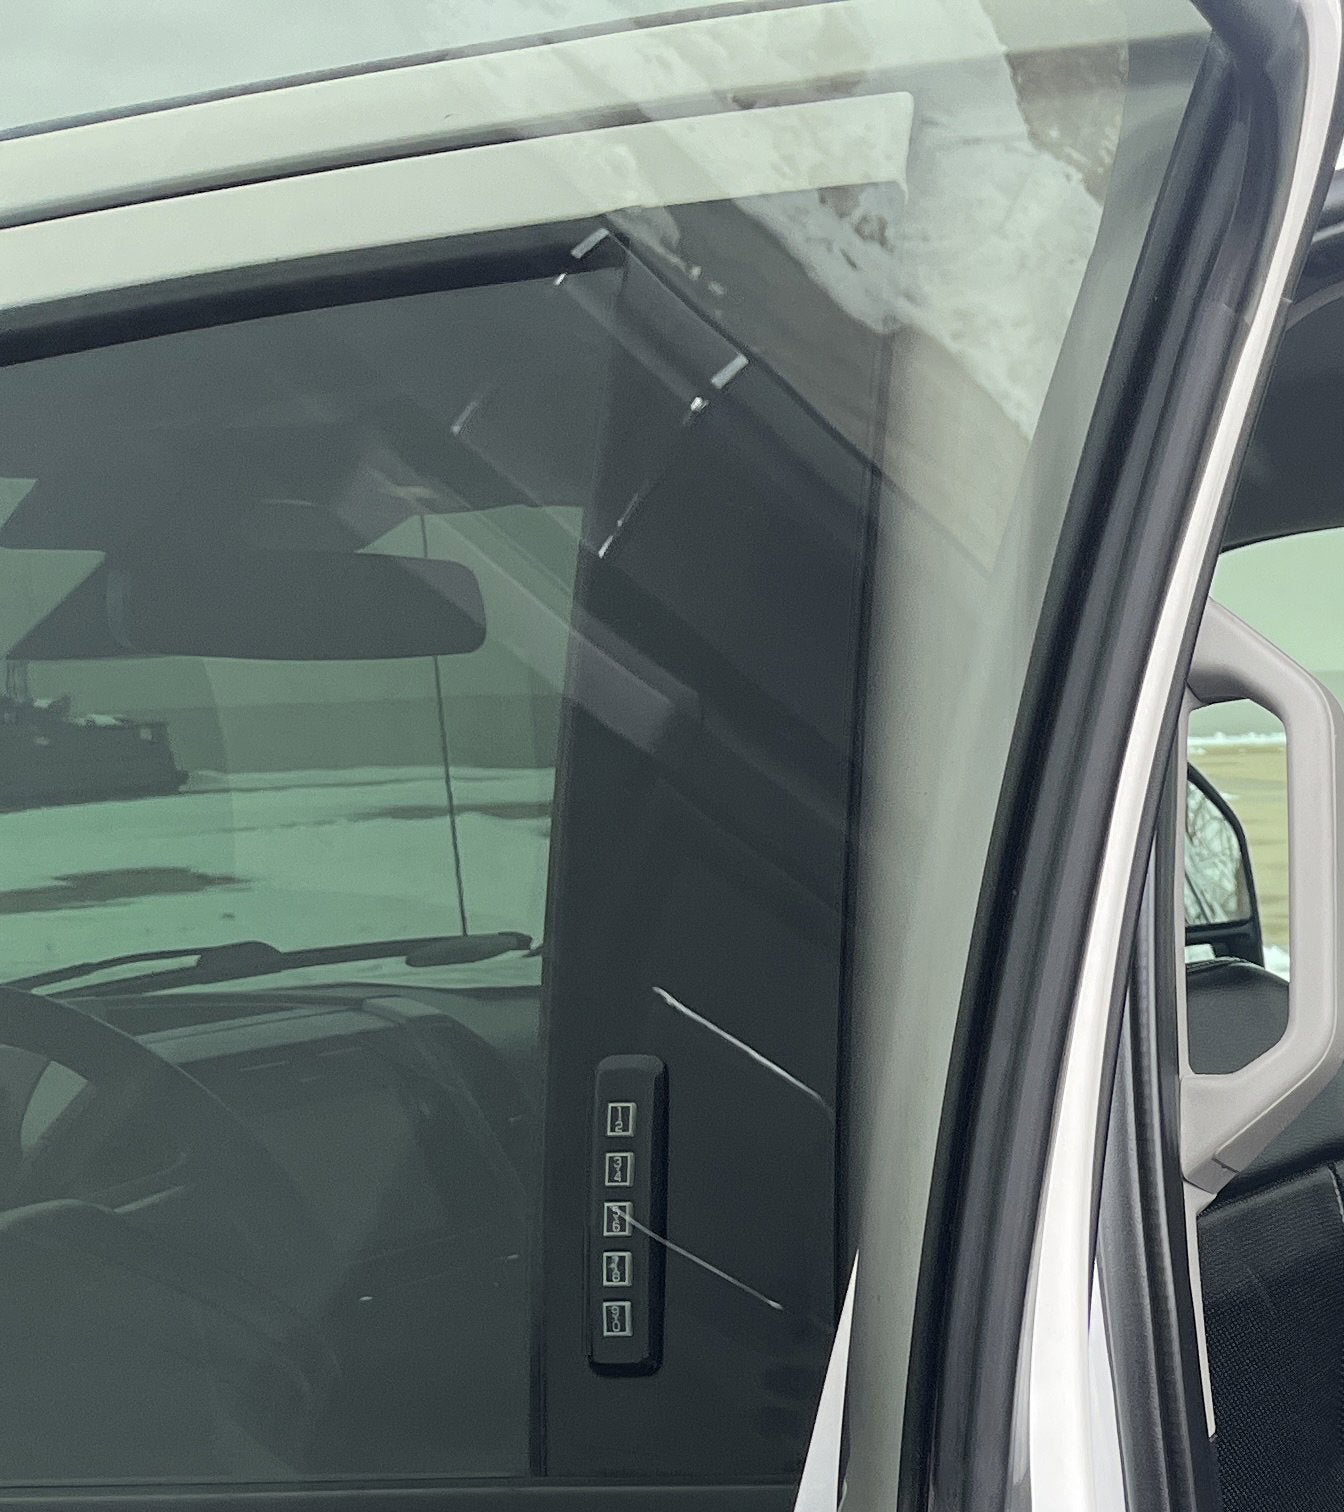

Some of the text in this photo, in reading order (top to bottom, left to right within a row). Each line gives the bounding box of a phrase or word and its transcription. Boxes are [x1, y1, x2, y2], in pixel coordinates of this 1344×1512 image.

[614, 1121, 623, 1133] 2
[613, 1156, 622, 1168] 3
[612, 1220, 621, 1232] 6
